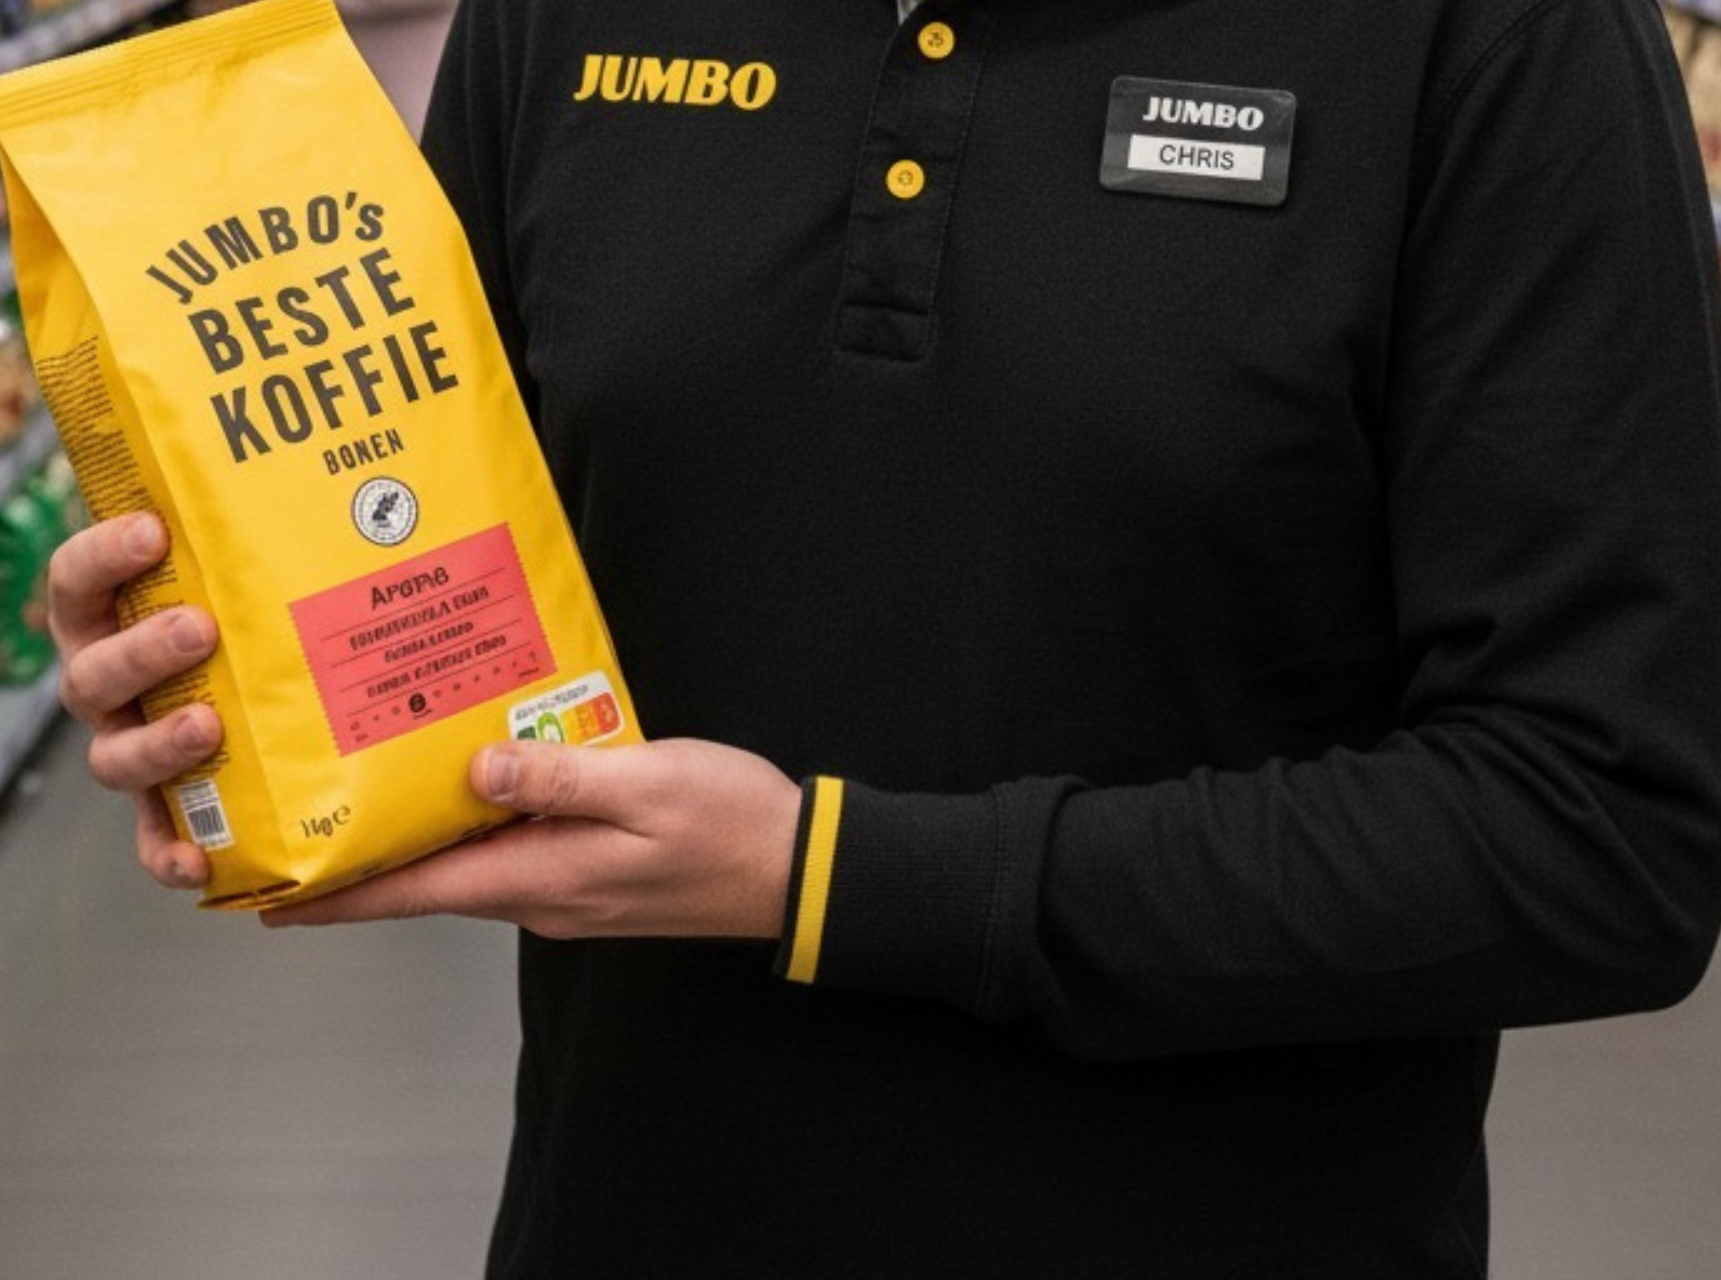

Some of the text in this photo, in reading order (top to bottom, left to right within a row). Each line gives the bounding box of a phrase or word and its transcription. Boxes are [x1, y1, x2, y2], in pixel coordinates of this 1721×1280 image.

[573, 55, 777, 111] JUMBO
[1142, 96, 1264, 131] JUMBO
[1159, 144, 1235, 170] CHRIS
[145, 191, 384, 305] JUMBO's
[188, 247, 416, 375] BESTE
[210, 320, 459, 463] KOFFIE
[322, 428, 404, 475] BONEN
